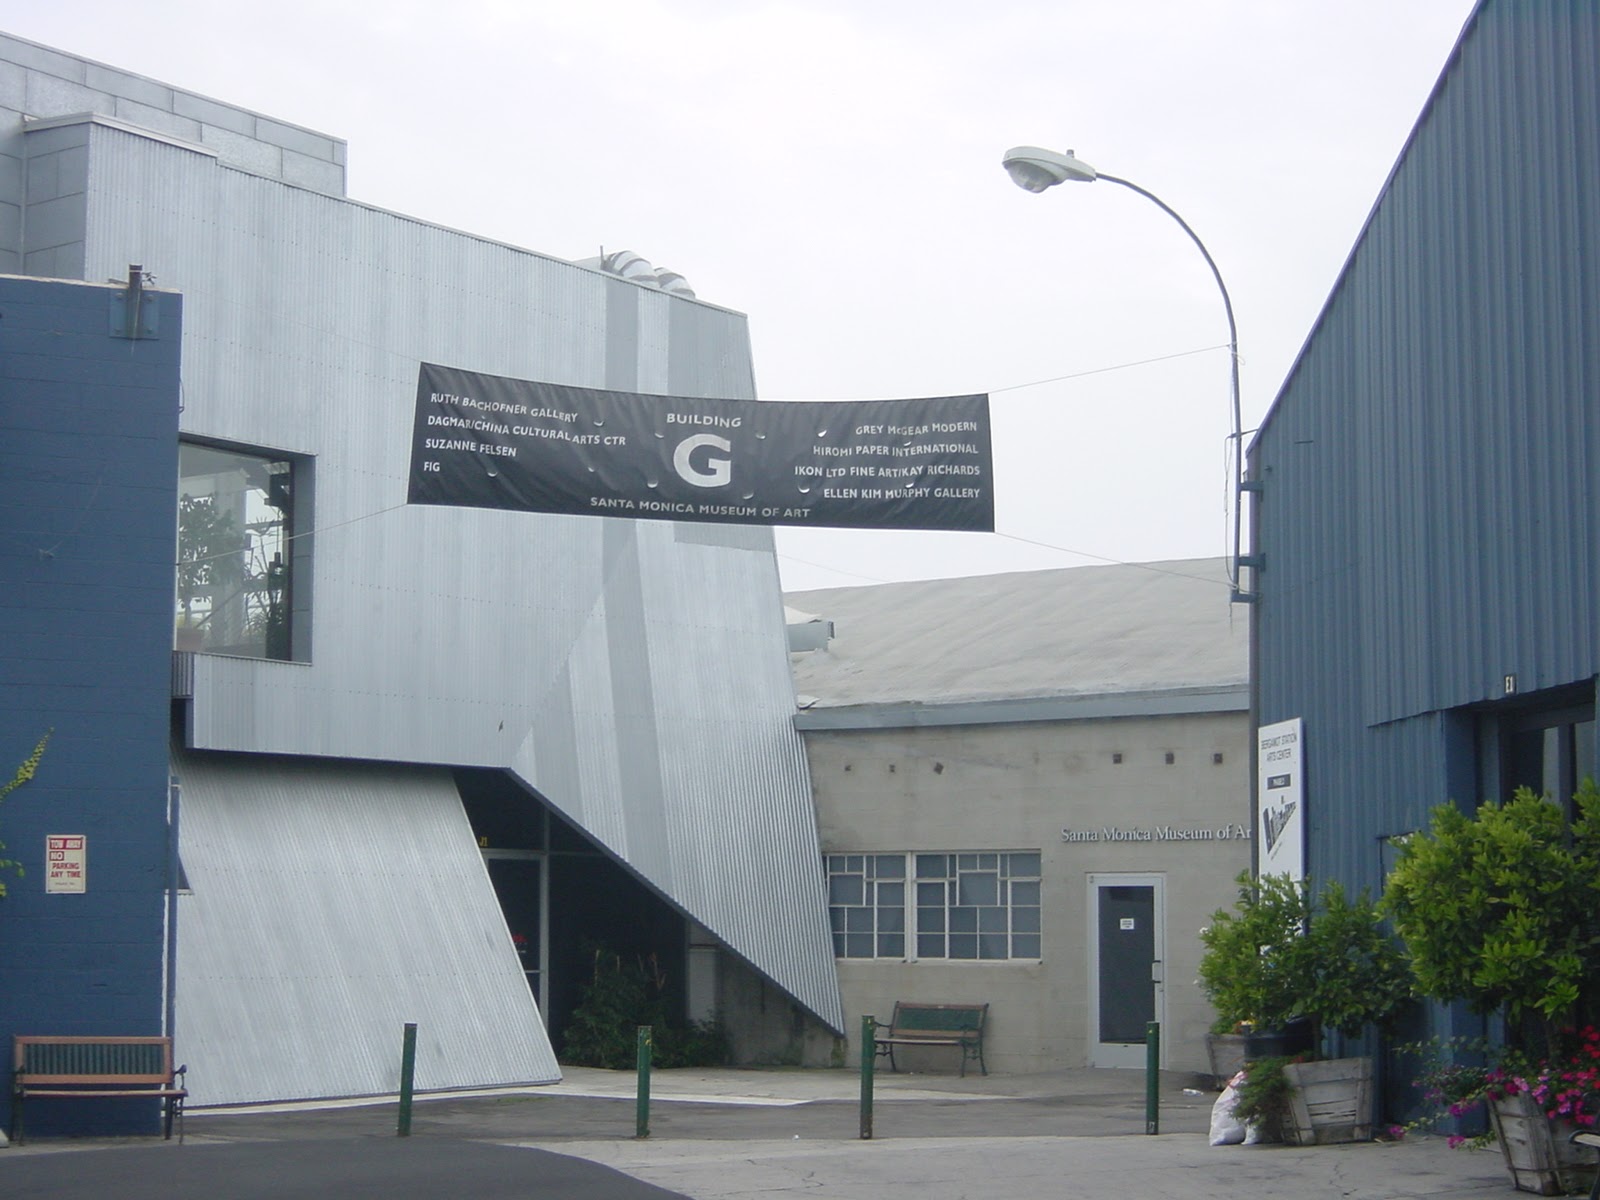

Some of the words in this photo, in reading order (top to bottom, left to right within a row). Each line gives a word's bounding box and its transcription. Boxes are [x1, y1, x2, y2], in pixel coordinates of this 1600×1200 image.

[431, 393, 459, 404] RUTH
[462, 397, 527, 415] BACHOFNER
[531, 408, 578, 422] GALLERY
[666, 413, 742, 428] BUILDING
[427, 415, 509, 435] DAGMAR/CHINA
[512, 426, 570, 441] CULTURAL
[572, 435, 600, 445] ARTS
[604, 436, 626, 446] CTR
[856, 425, 883, 435] GREY
[888, 425, 929, 436] McGEAR
[932, 422, 977, 433] MODERN
[425, 438, 476, 451] SUZANNE
[480, 443, 517, 457] FELSEN
[813, 446, 852, 457] HIROMI
[855, 446, 889, 455] PAPER
[892, 444, 979, 457] INTERNATIONAL
[424, 461, 440, 472] FIG
[673, 433, 731, 488] G
[795, 466, 823, 476] IKON
[826, 468, 846, 478] LTD
[850, 467, 875, 477] FINE
[878, 465, 923, 478] ART/KAY
[927, 465, 980, 475] RICHARDS
[824, 488, 857, 498] ELLEN
[861, 488, 881, 498] KIM
[885, 488, 930, 499] MURPHY
[934, 488, 980, 498] GALLERY
[590, 497, 635, 509] SANTA
[639, 500, 694, 513] MONICA
[699, 505, 757, 516] MUSEUM
[762, 508, 780, 517] OF
[783, 508, 811, 518] ART
[1061, 828, 1098, 842] Santa
[1102, 826, 1151, 841] Monica
[1155, 825, 1212, 841] Museum
[1216, 824, 1232, 839] of
[1234, 825, 1251, 839] Ar
[50, 851, 63, 860] NO
[52, 862, 80, 870] PARKING
